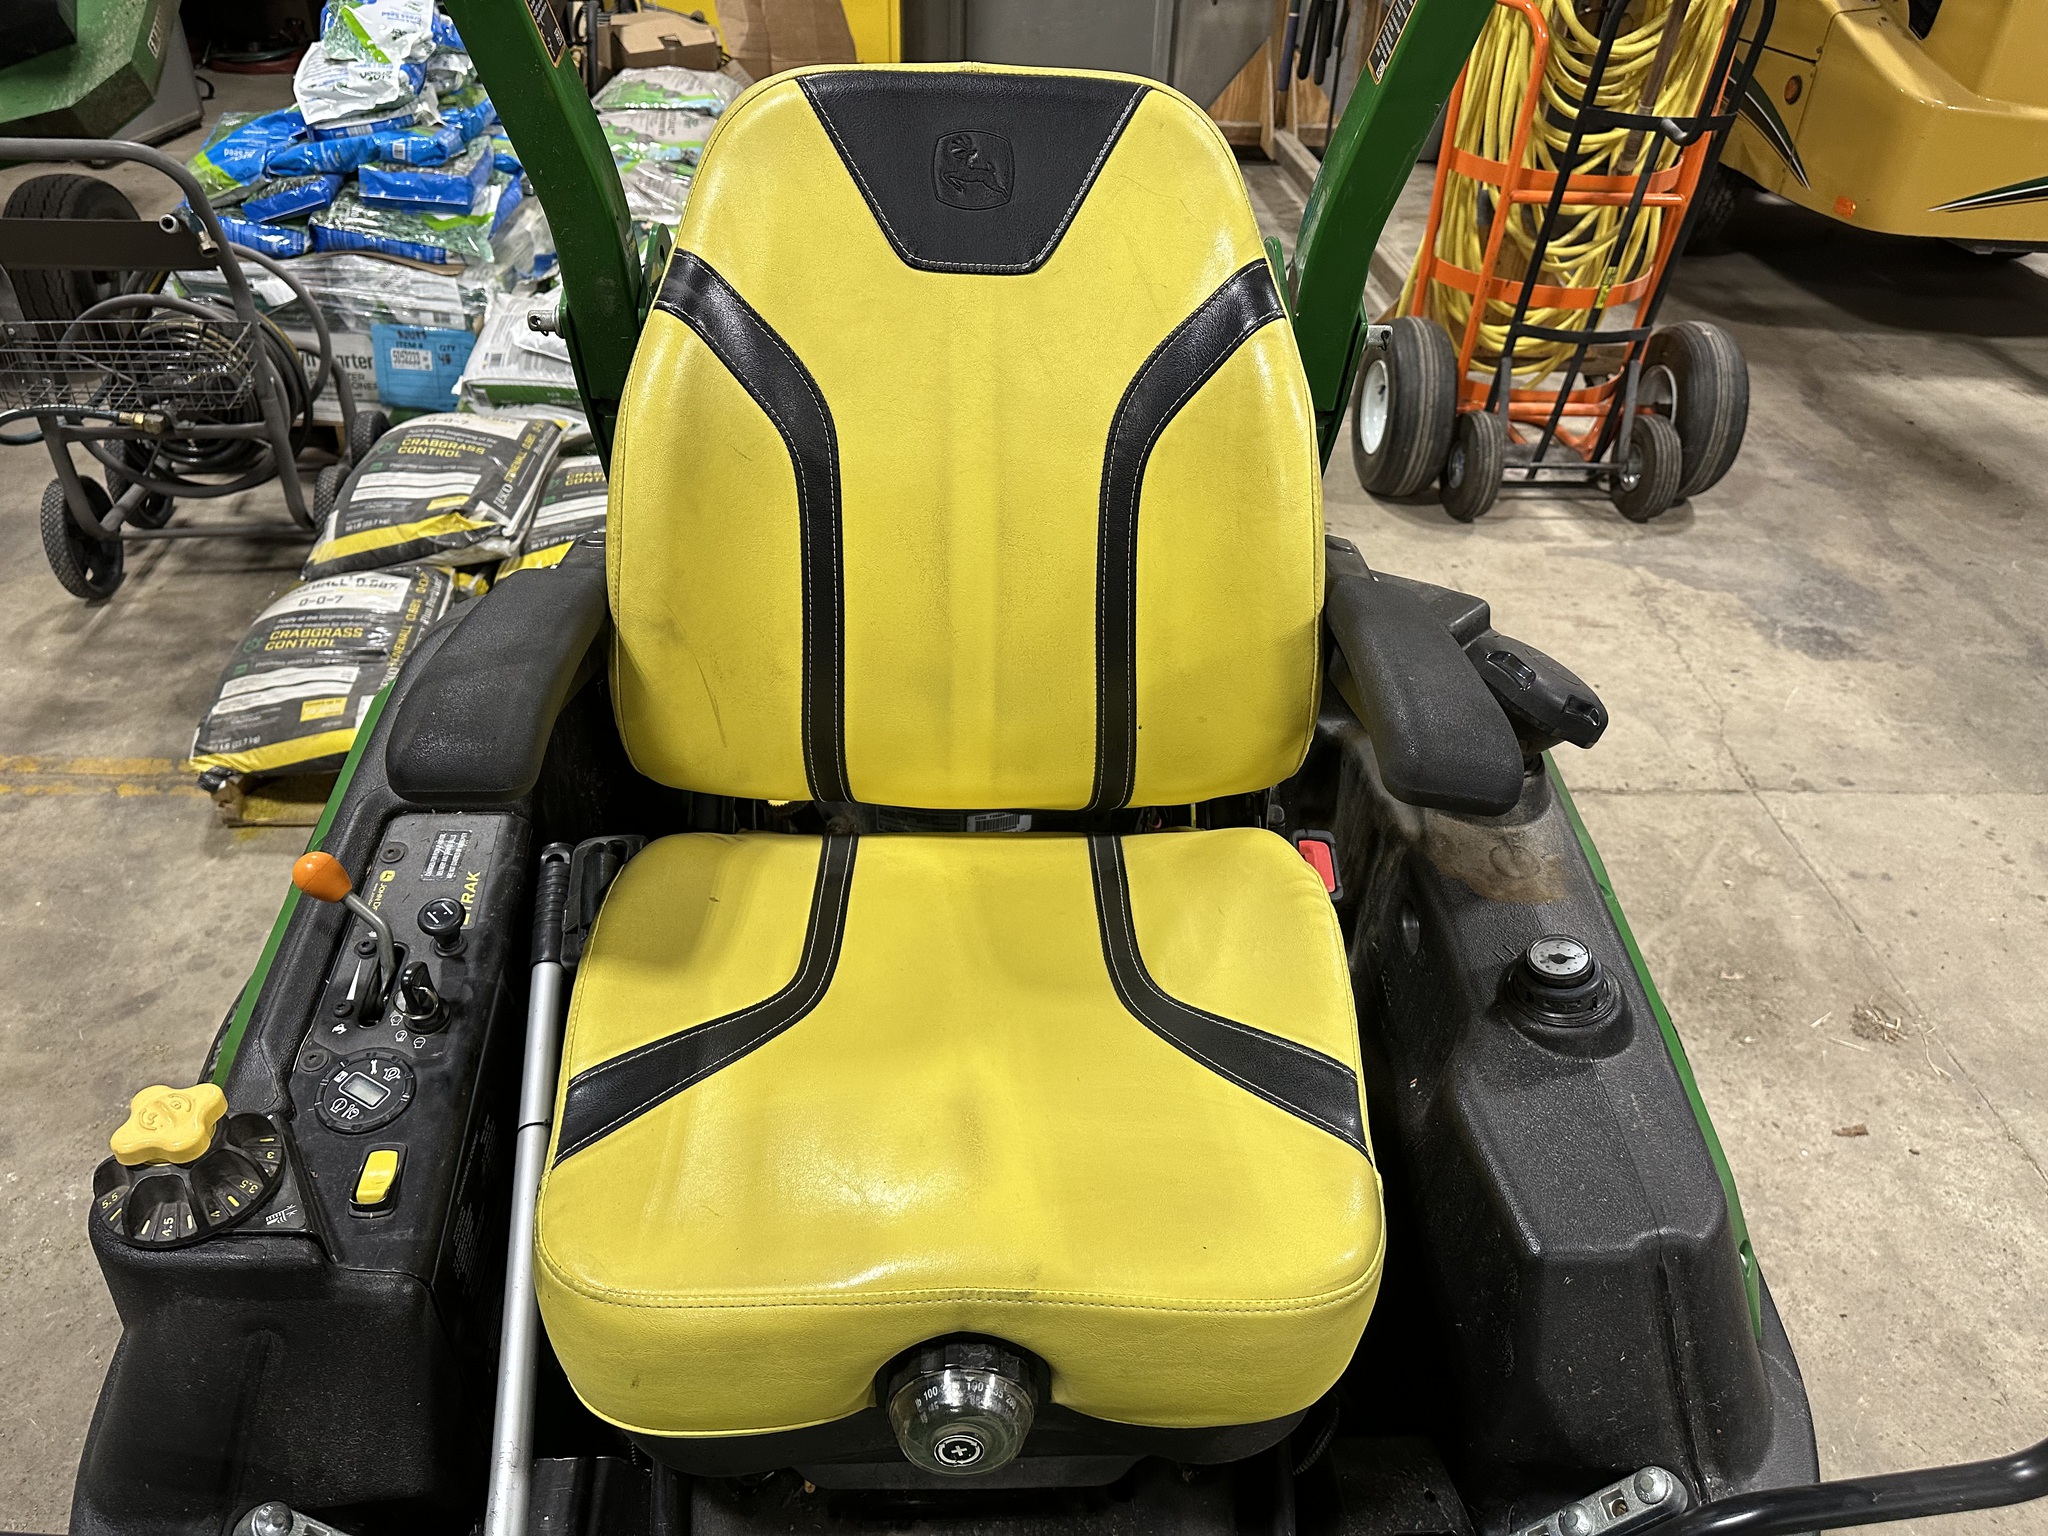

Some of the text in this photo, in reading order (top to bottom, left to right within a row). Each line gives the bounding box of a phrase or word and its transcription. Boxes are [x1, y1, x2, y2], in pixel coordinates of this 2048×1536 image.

[397, 446, 462, 458] CONTROL
[401, 437, 486, 456] CRABGRASS
[298, 595, 344, 607] 0-0-7
[269, 627, 364, 641] CRABGRASS
[264, 638, 337, 651] CONTROL
[266, 1151, 275, 1159] 3
[239, 1179, 259, 1194] 3.5
[101, 1192, 118, 1210] 5.5
[161, 1216, 174, 1237] 4.5
[923, 1386, 938, 1401] 100
